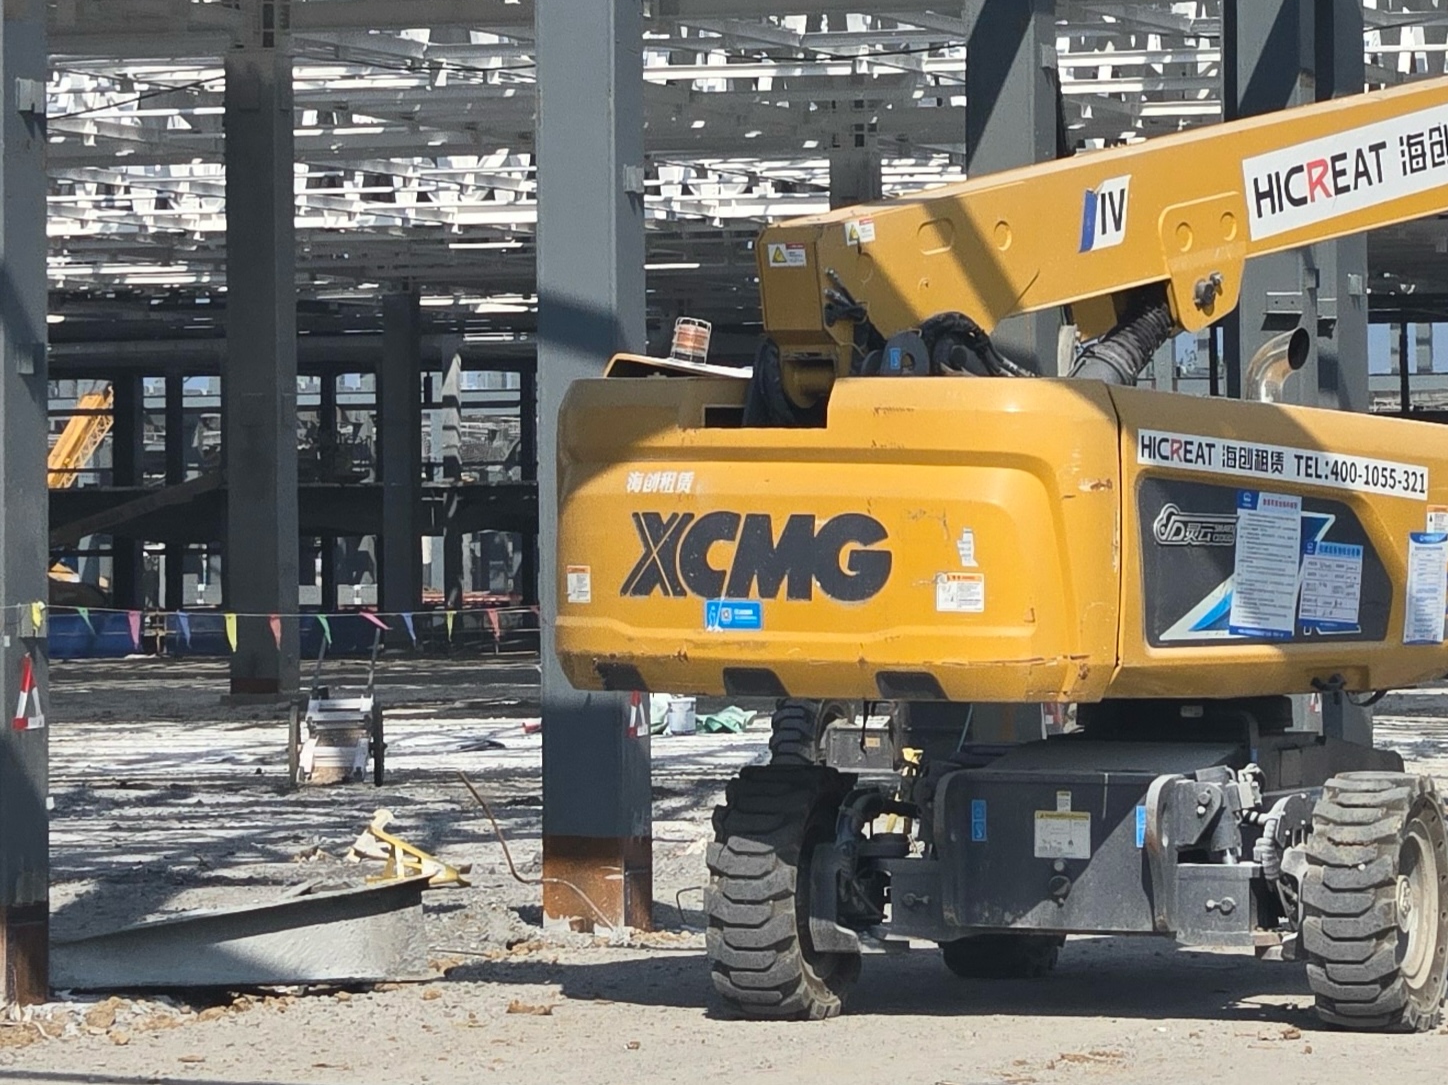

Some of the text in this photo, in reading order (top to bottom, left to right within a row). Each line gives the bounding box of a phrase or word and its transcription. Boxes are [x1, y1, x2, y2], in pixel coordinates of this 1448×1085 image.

[1253, 141, 1387, 219] HICREAT
[1101, 188, 1126, 236] IV
[626, 471, 695, 494] 海创租赁
[1140, 434, 1426, 494] HICREAT 海创租赁 TEL:400-1055-321
[619, 511, 893, 602] XCMG
